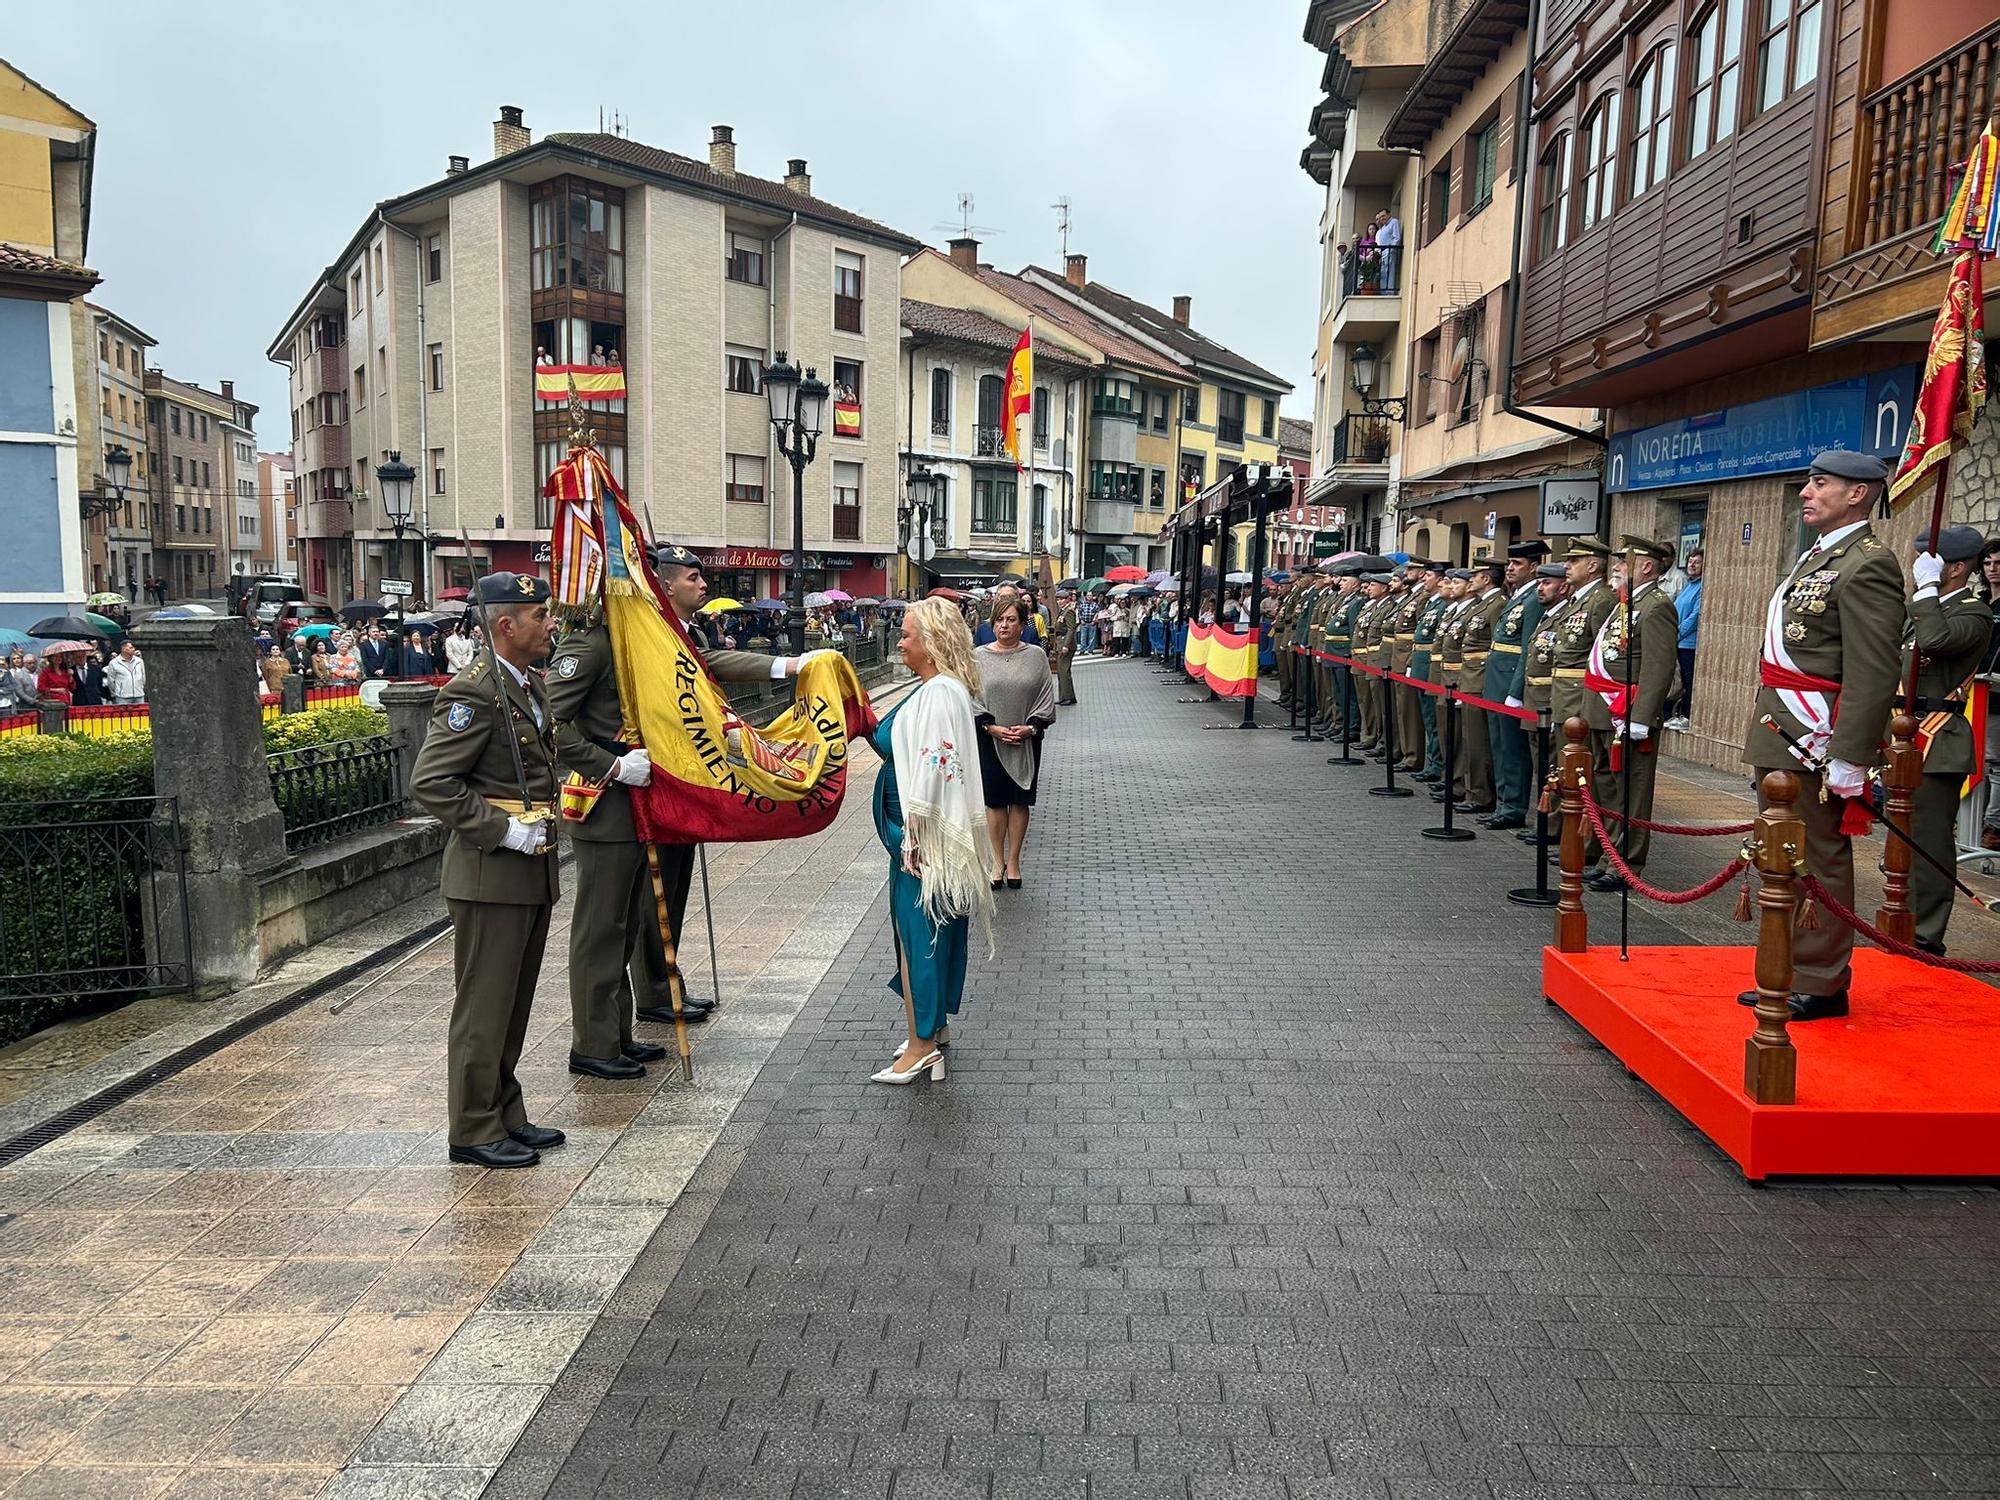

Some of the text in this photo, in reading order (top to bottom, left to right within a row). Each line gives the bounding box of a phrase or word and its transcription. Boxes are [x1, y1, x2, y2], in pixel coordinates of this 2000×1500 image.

[1716, 457, 1739, 470] Parcelas
[1742, 452, 1764, 466] Locales
[1764, 448, 1802, 463] Comerciales
[1547, 500, 1595, 516] HATCHET
[540, 543, 552, 552] Ca
[534, 552, 552, 562] Cha
[728, 550, 742, 566] de
[744, 551, 779, 567] Marco
[674, 650, 848, 817] REGIMIENTO PRINCIPE
